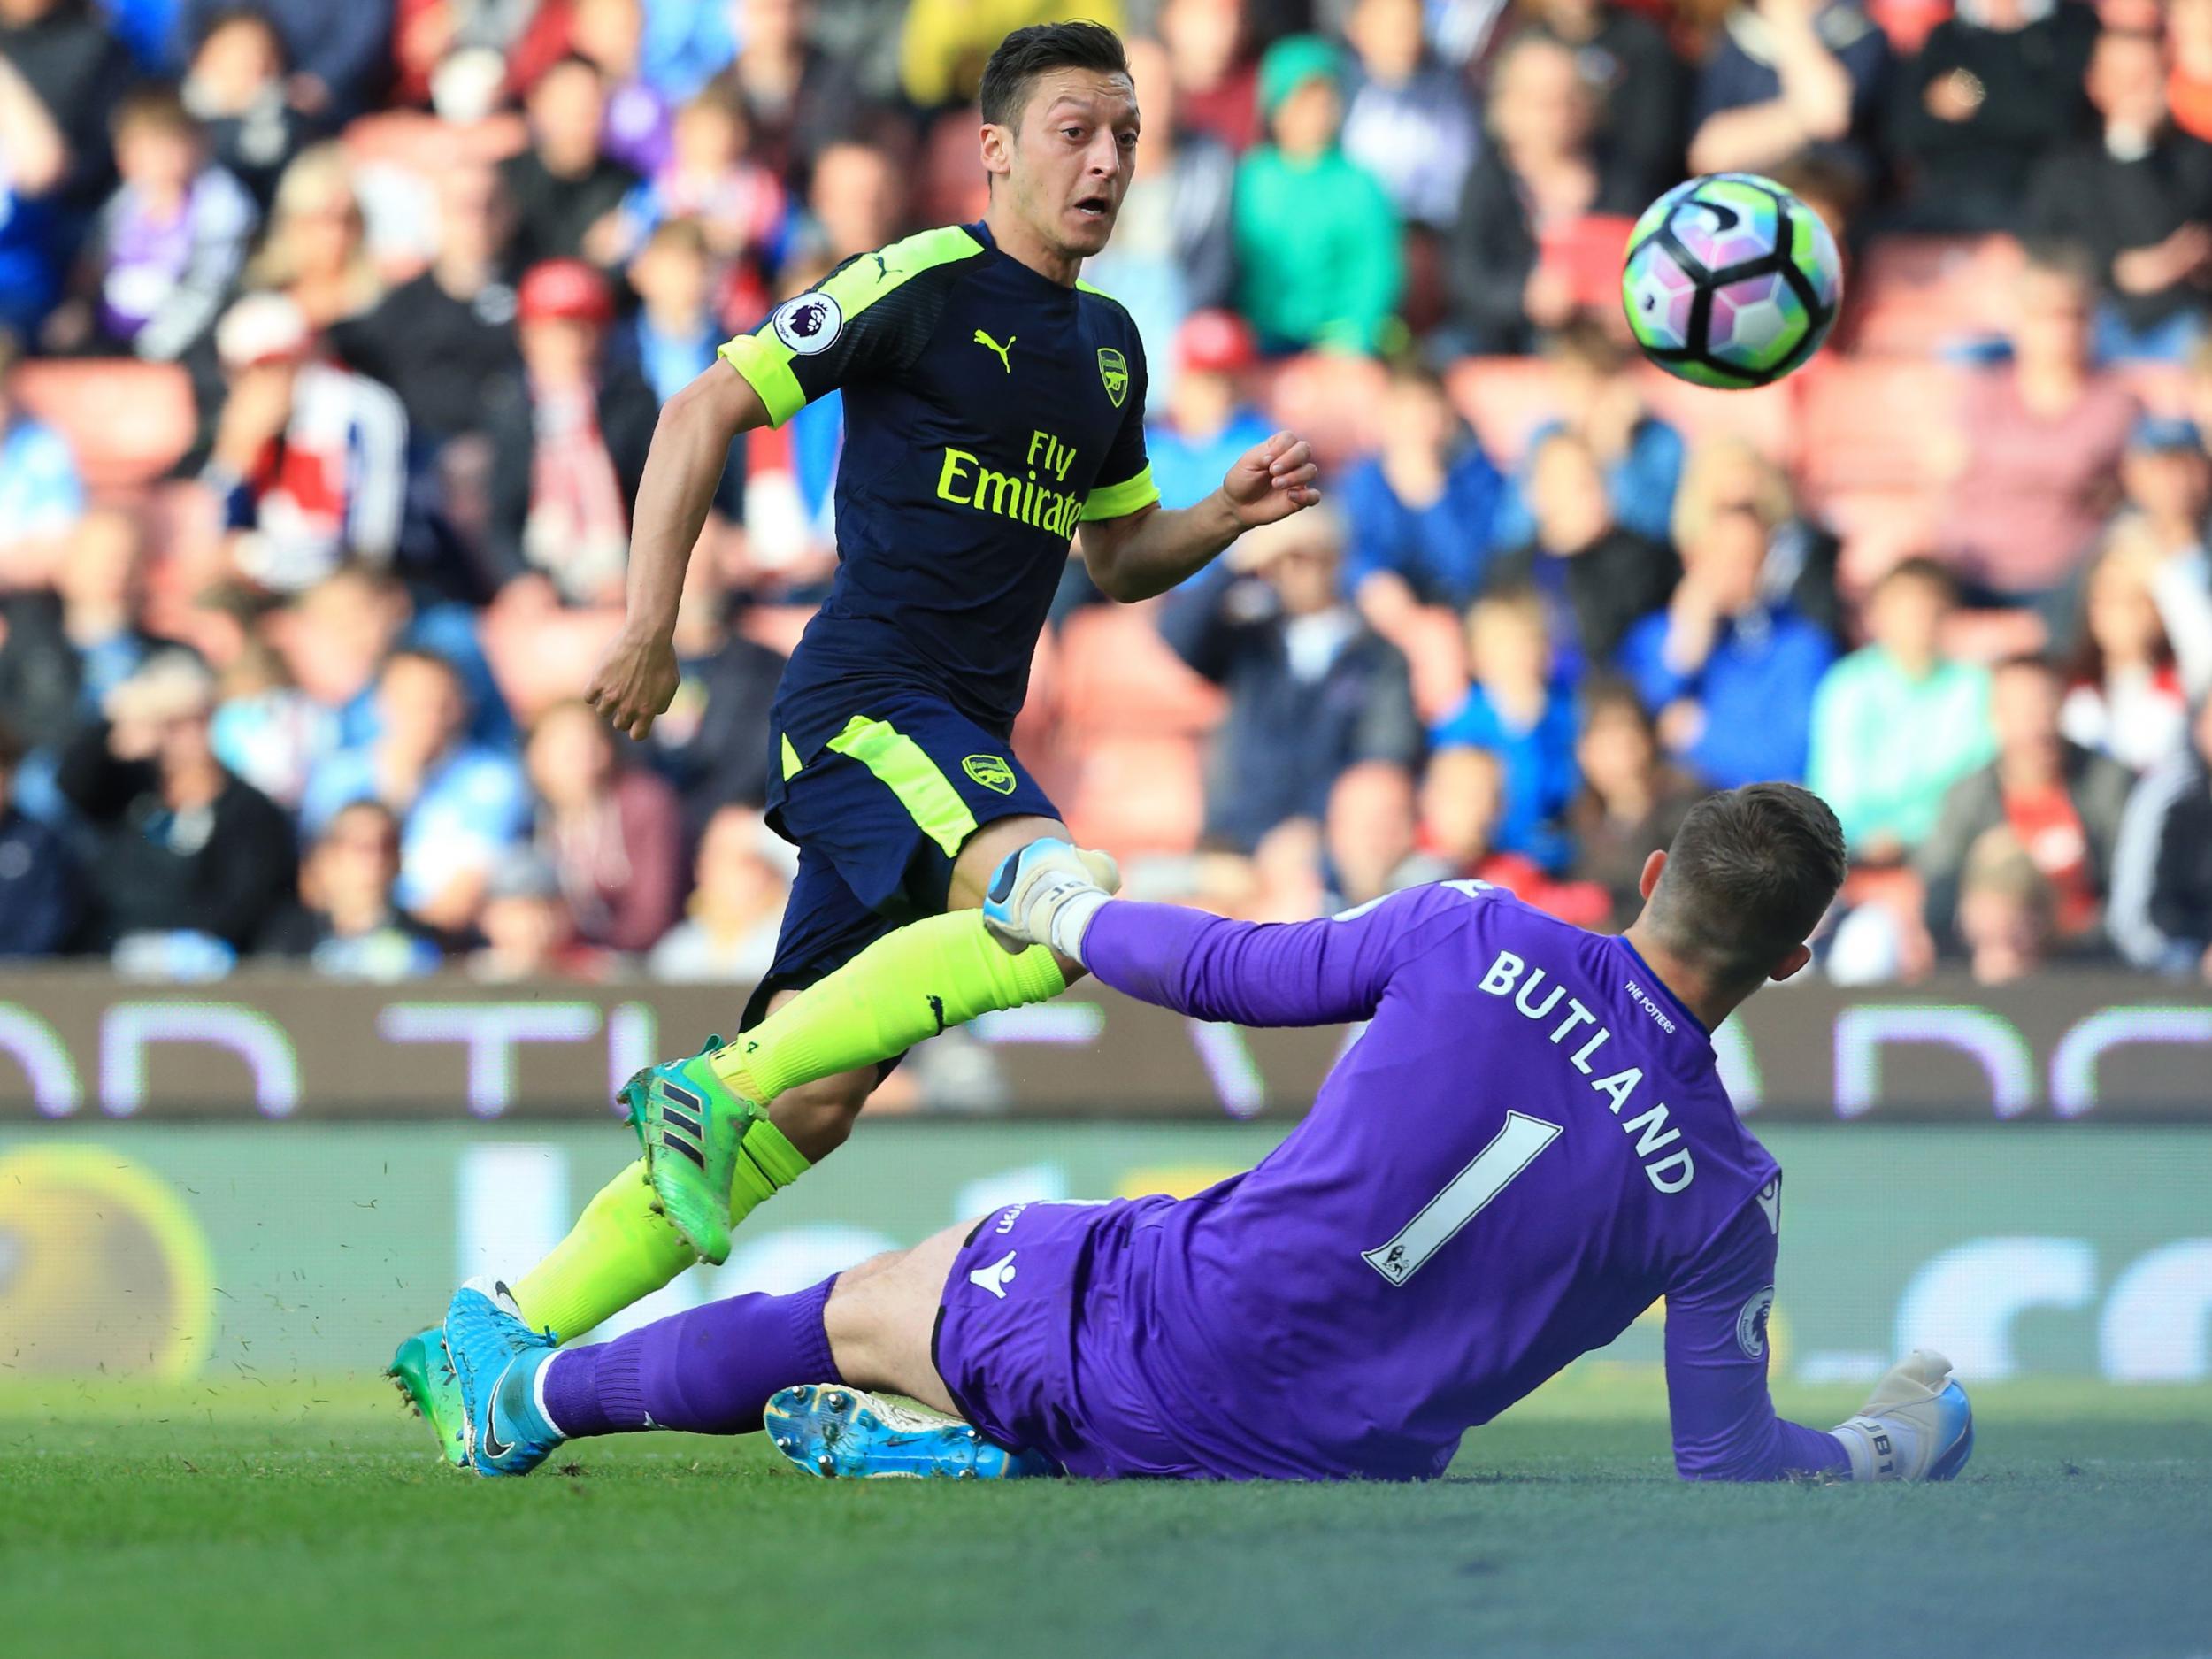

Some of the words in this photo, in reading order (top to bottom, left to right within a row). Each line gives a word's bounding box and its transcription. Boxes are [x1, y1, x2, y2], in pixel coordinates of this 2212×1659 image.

[1026, 429, 1077, 482] Fly
[936, 446, 1082, 541] Emirate
[1624, 979, 1644, 1001] THE
[1639, 996, 1676, 1034] POTTERS
[1477, 949, 1695, 1194] BUTLAND
[1361, 1109, 1564, 1287] 1
[1856, 1421, 1894, 1475] JB1
